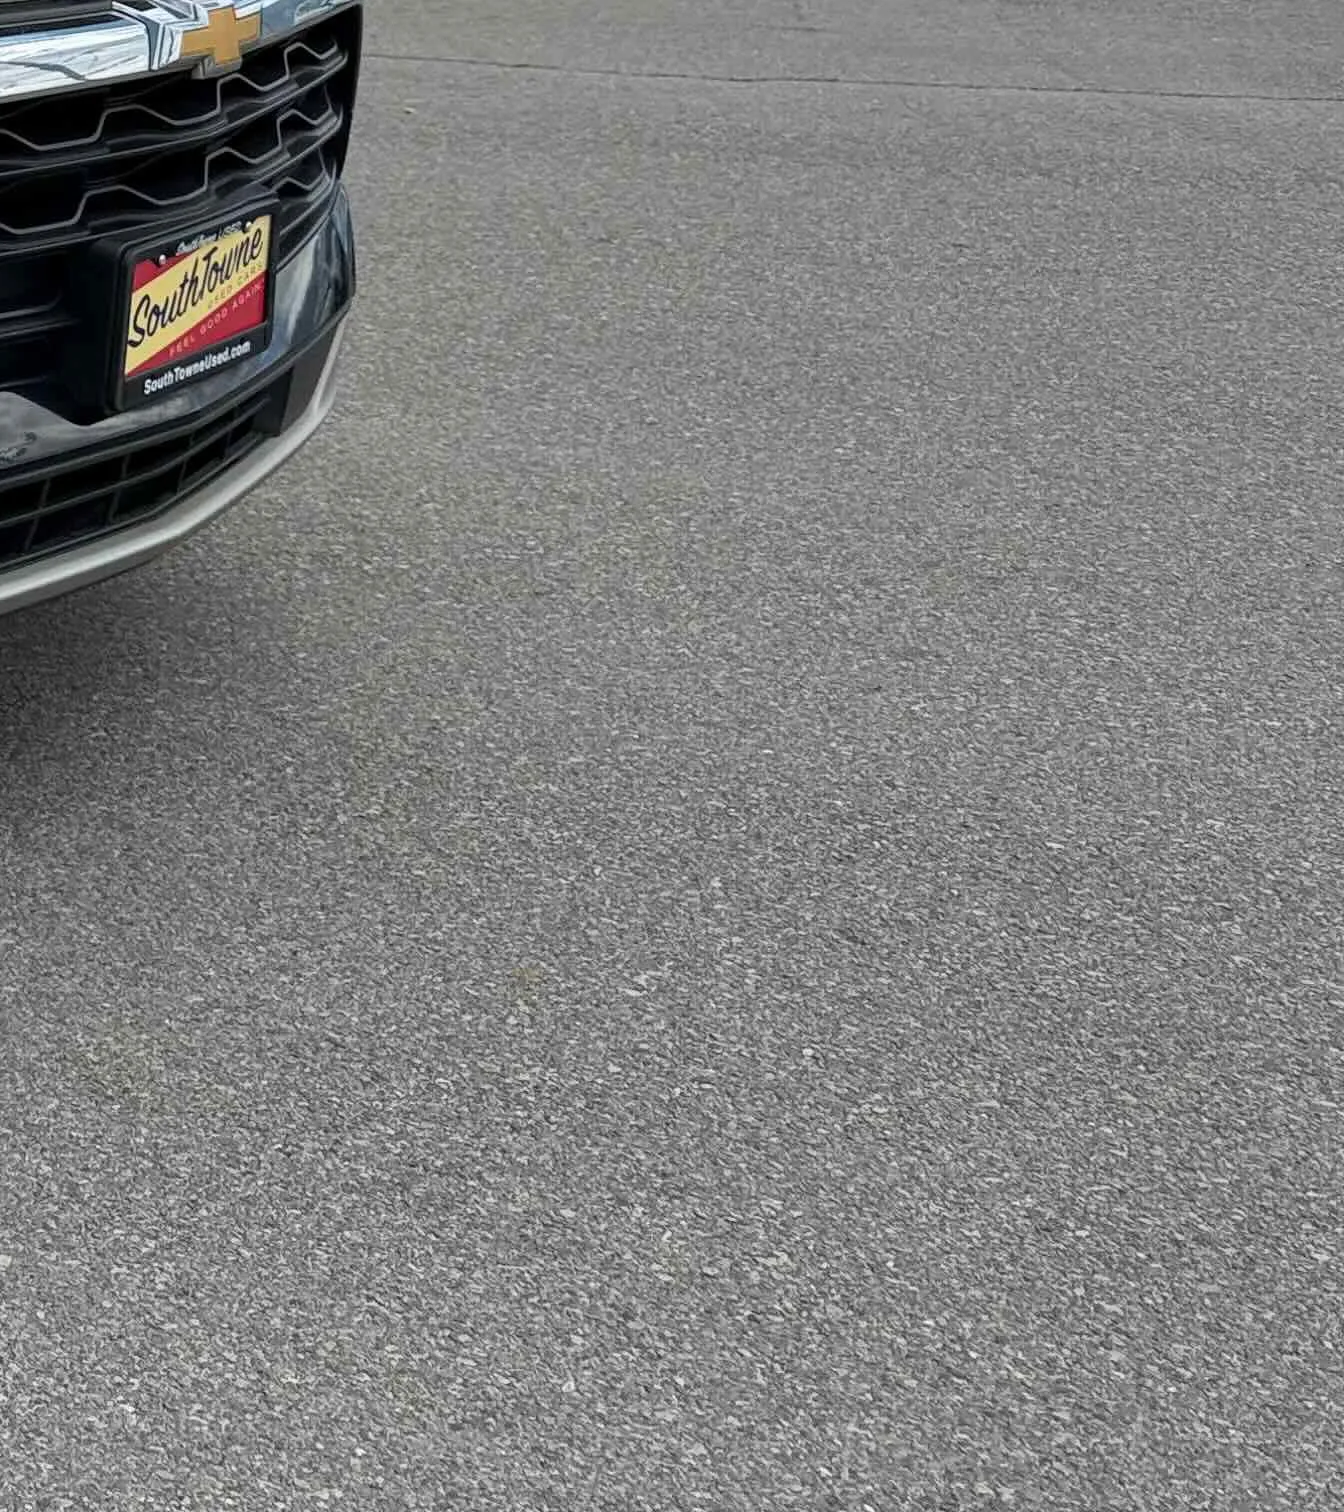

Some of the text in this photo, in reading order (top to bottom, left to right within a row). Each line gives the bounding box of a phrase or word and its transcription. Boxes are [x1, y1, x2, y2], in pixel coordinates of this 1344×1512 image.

[169, 335, 196, 359] FEEL
[199, 308, 229, 335] GOOD
[143, 340, 252, 395] SouthTowneUsed.com
